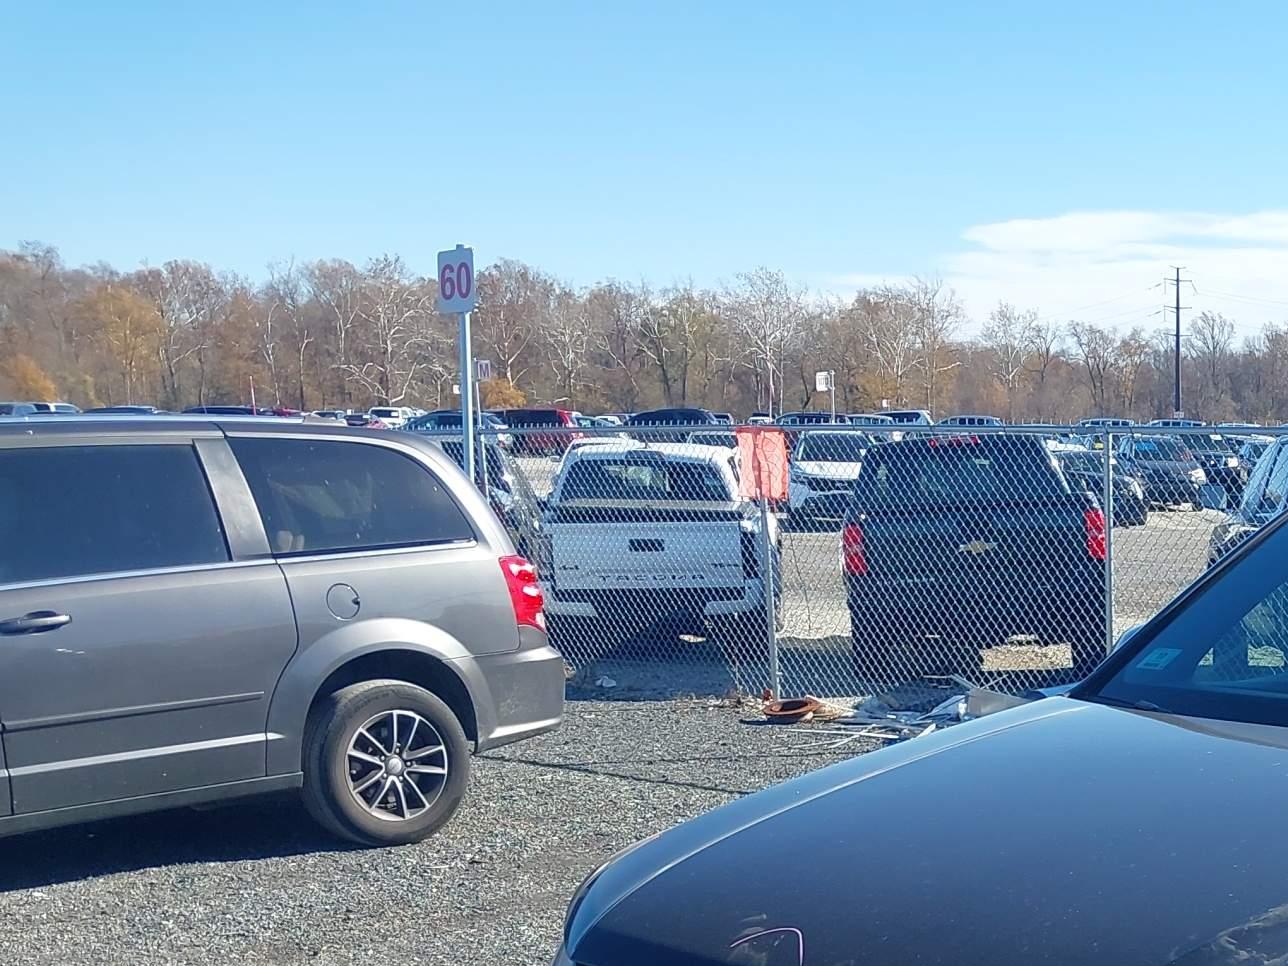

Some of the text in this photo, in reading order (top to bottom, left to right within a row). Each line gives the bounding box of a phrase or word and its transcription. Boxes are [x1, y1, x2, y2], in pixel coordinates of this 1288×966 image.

[440, 261, 471, 300] 60
[479, 362, 490, 378] M
[598, 574, 705, 582] TACOMA
